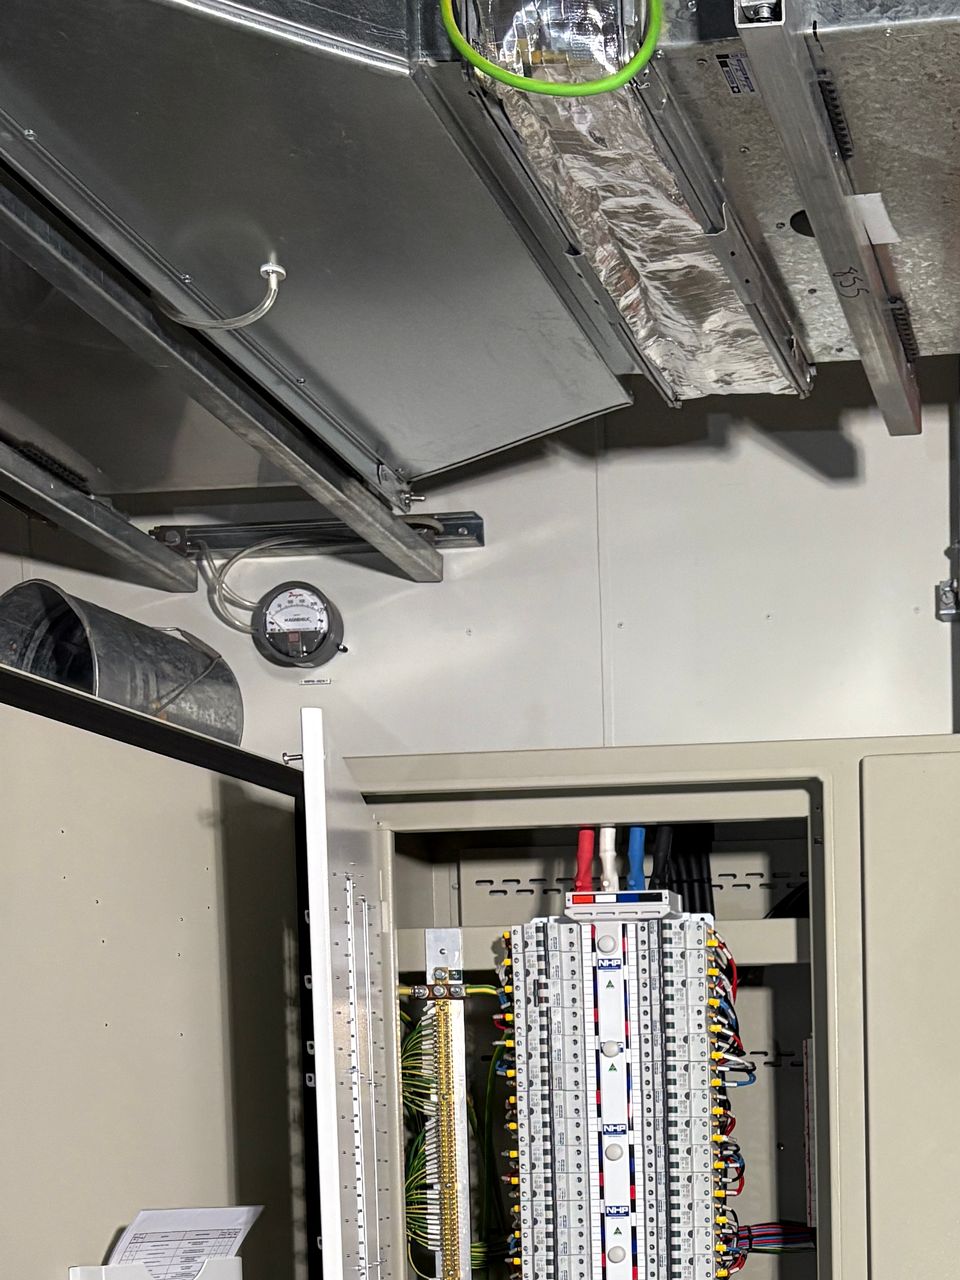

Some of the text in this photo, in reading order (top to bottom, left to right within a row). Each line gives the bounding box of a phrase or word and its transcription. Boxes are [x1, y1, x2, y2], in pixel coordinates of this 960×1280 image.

[832, 266, 869, 299] 855
[598, 959, 621, 967] NHP
[603, 1124, 626, 1132] NHP
[607, 1206, 629, 1214] NHP
